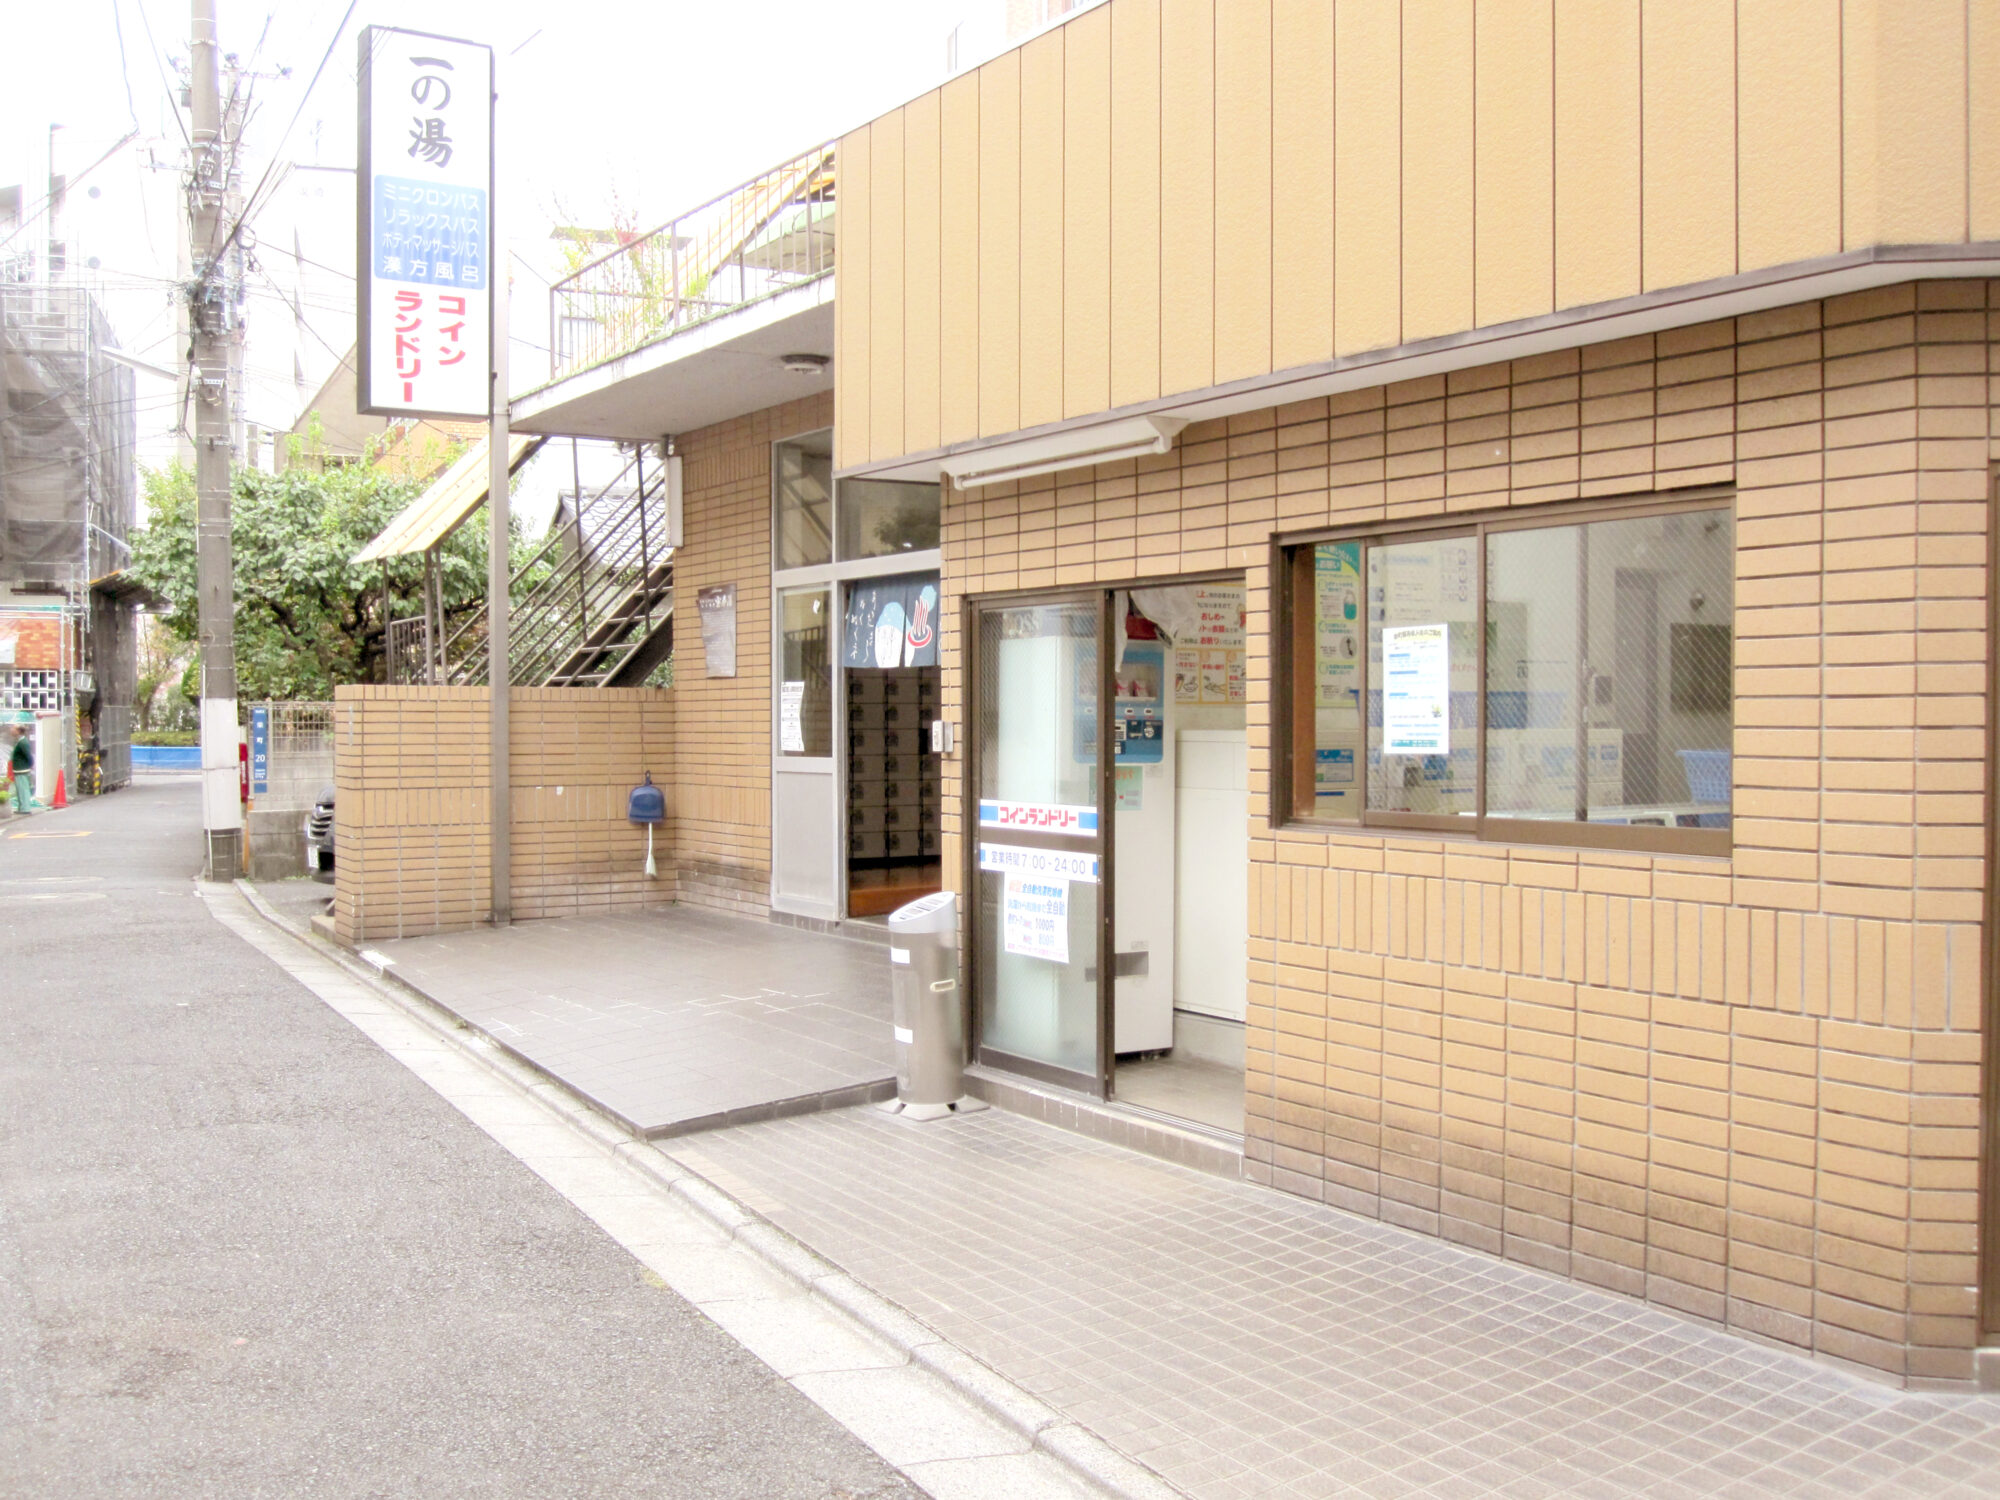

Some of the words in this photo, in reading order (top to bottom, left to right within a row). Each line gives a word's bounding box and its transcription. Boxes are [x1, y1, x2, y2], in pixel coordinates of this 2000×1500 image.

[407, 56, 455, 169] 一の湯
[383, 207, 481, 235] リラックスバス
[382, 255, 480, 283] 漢方風呂
[438, 294, 466, 366] コイン
[394, 290, 423, 403] ランドリー
[255, 754, 266, 763] 20
[999, 806, 1078, 828] コインランドリー
